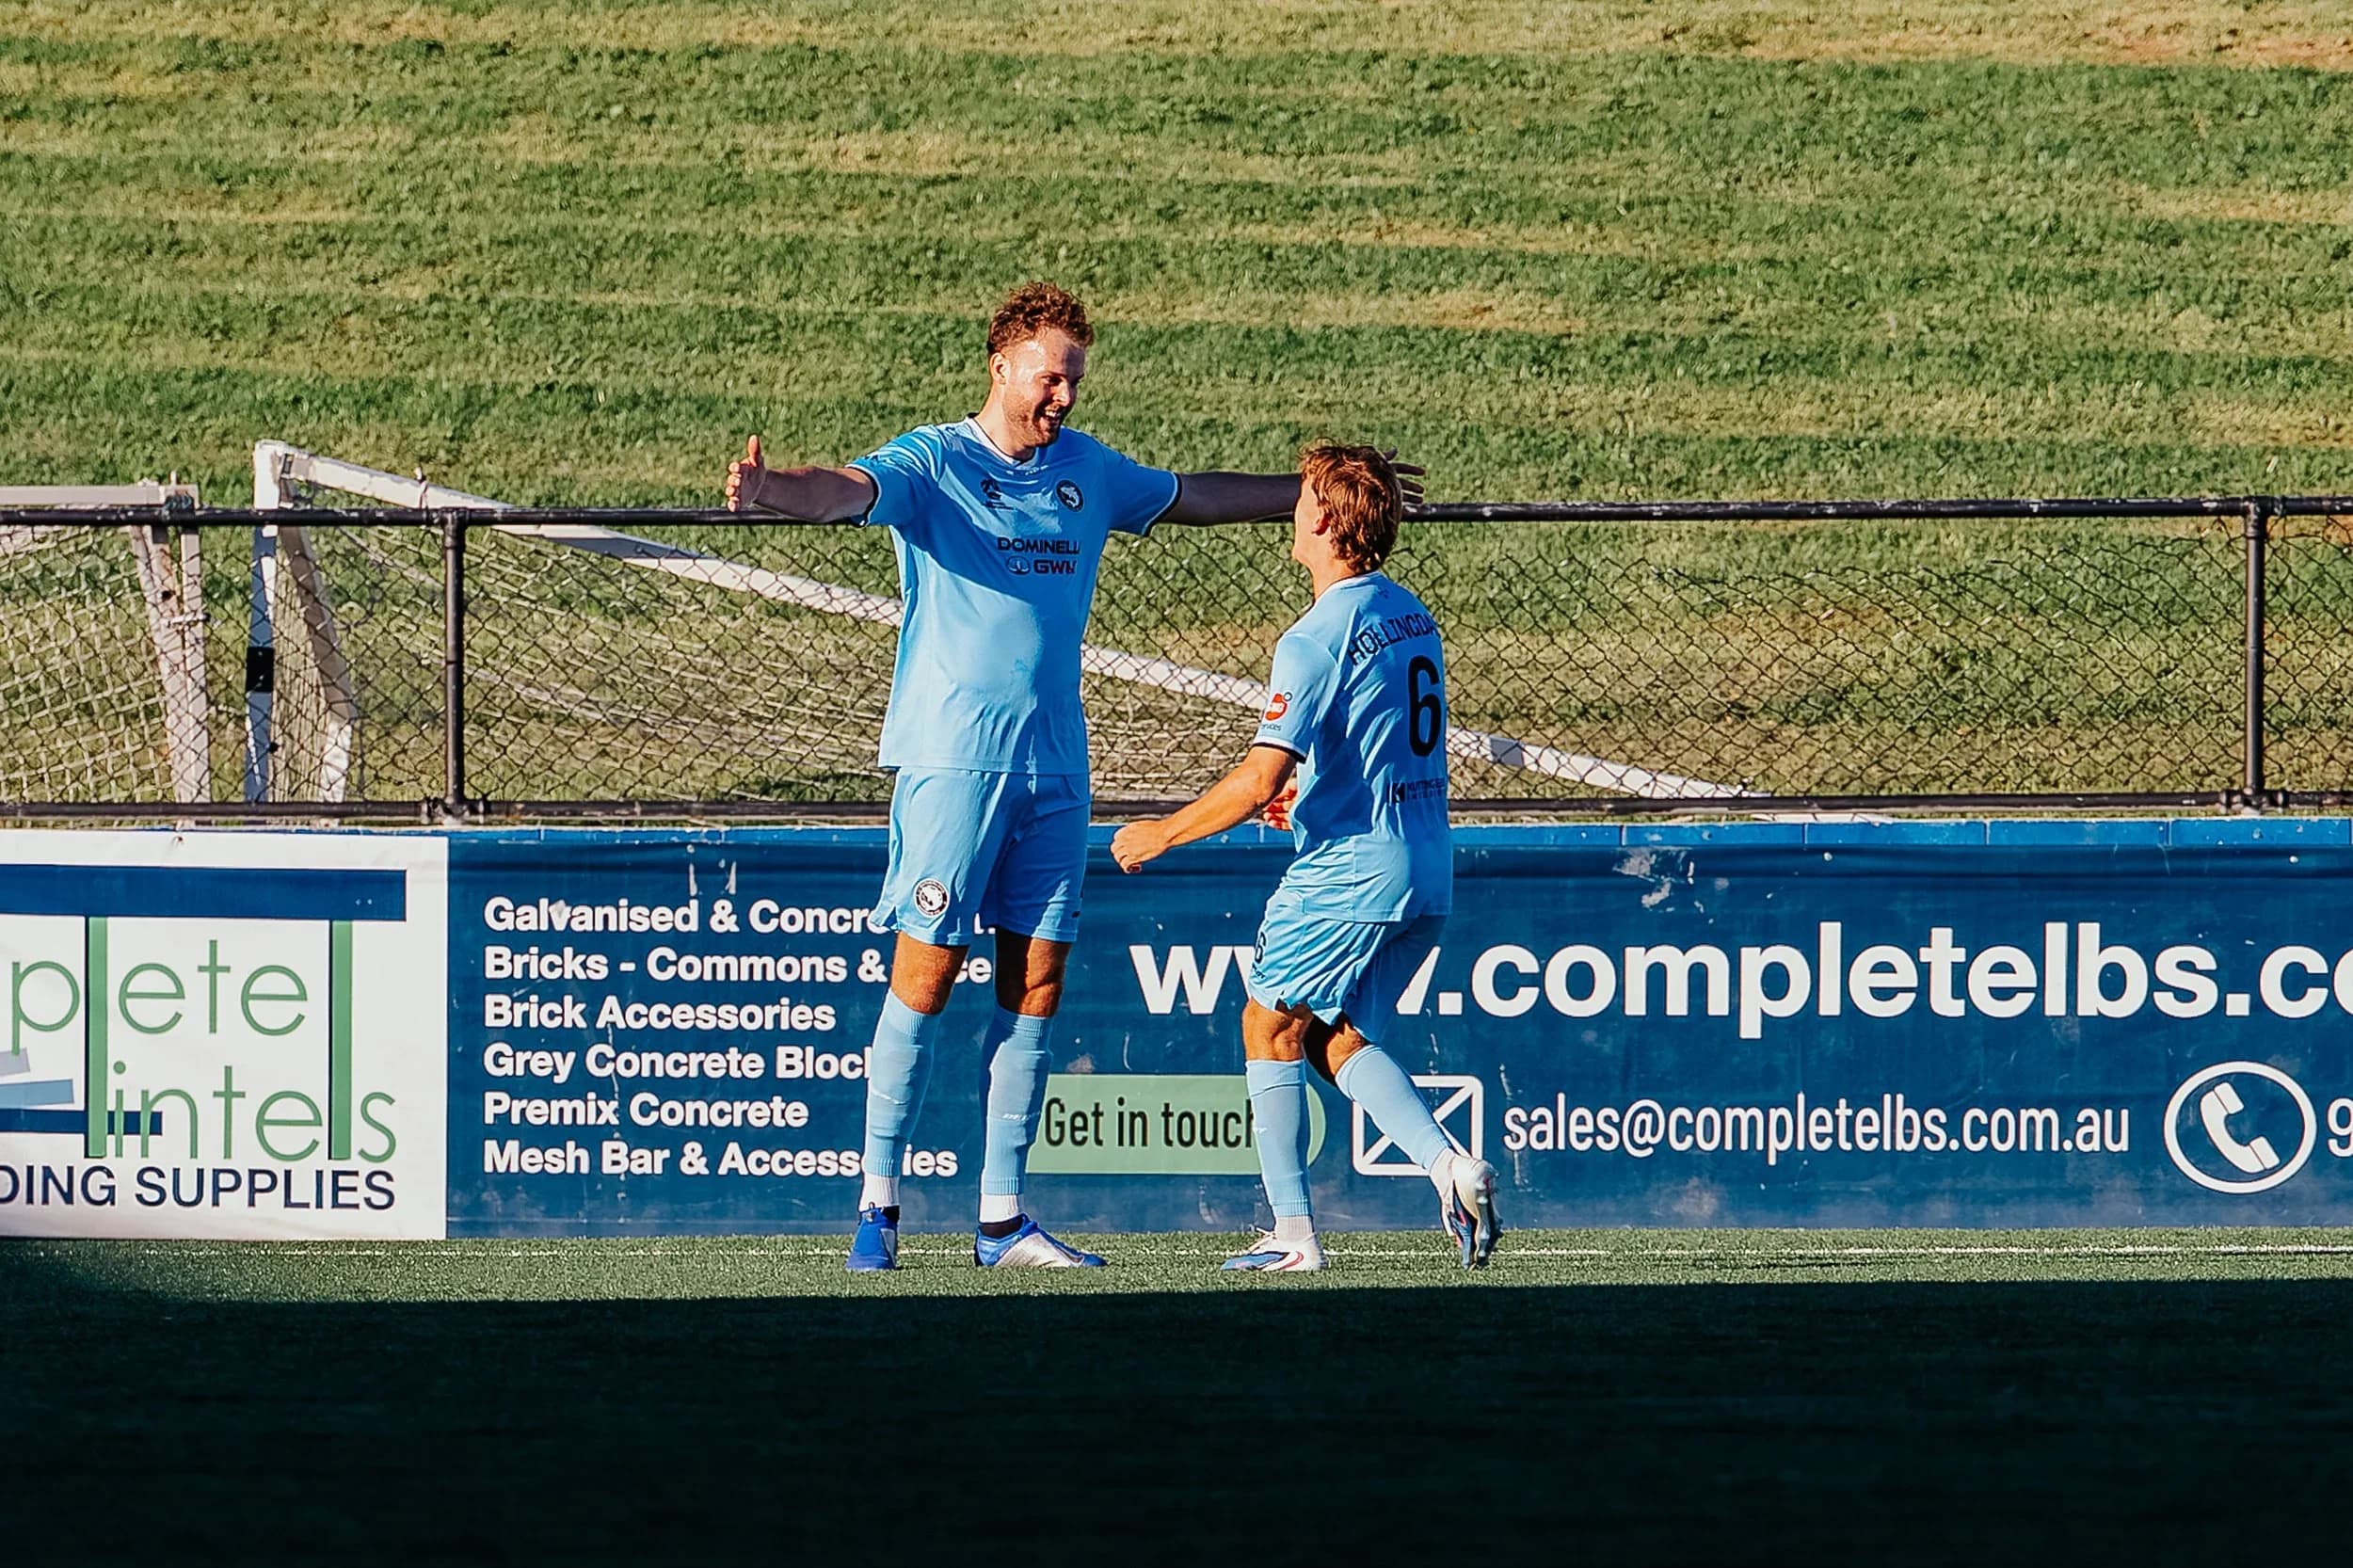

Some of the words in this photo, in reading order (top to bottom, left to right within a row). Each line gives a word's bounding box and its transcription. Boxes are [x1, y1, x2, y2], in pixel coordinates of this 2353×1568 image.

[1408, 654, 1442, 757] 6
[483, 896, 699, 934] Galvanised
[710, 899, 740, 934] &
[749, 899, 889, 935] Concr
[484, 946, 609, 981] Bricks
[619, 962, 636, 971] -
[647, 947, 848, 983] Commons
[857, 949, 888, 983] &
[1128, 921, 2353, 1039] w.completelbs.c
[484, 994, 587, 1029] Brick
[596, 995, 837, 1031] Accessories
[484, 1042, 577, 1084] Grey
[585, 1044, 765, 1080] Concrete
[484, 1091, 619, 1126] Premix
[630, 1092, 808, 1128] Concrete
[1044, 1096, 1104, 1147] Get
[1117, 1096, 1148, 1147] in
[1503, 1092, 2130, 1166] sales@completelbs.com.au
[484, 1140, 589, 1174] Mesh
[601, 1141, 670, 1175] Bar
[680, 1141, 710, 1176] &
[717, 1142, 959, 1177] Accessies
[136, 1167, 395, 1210] SUPPLIES
